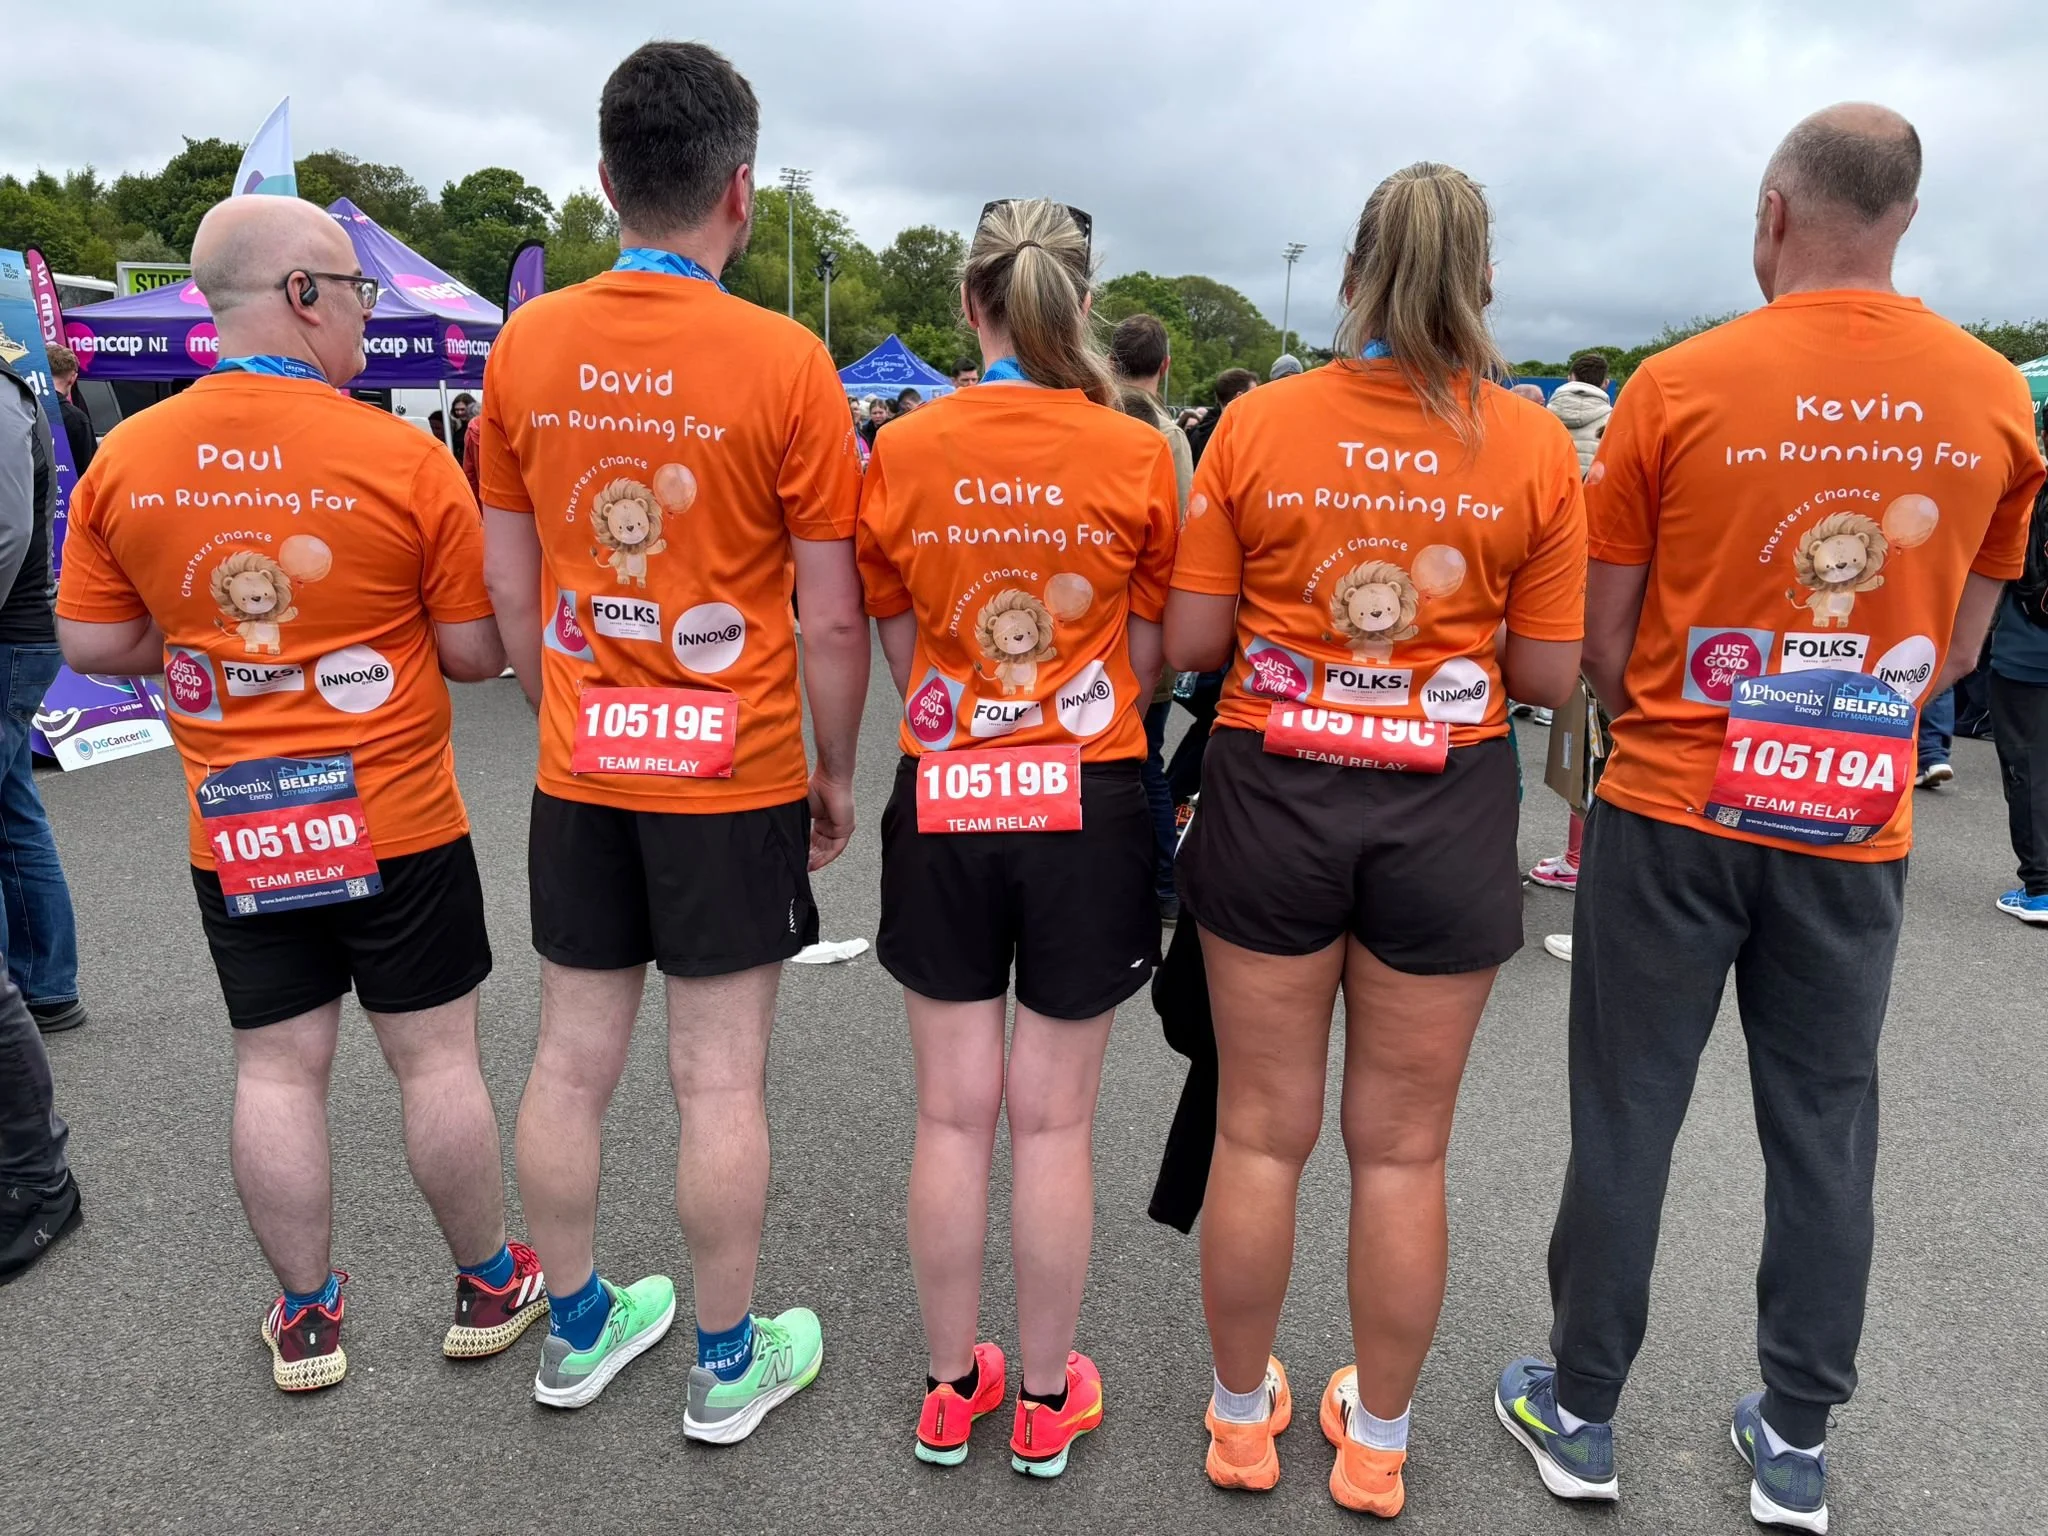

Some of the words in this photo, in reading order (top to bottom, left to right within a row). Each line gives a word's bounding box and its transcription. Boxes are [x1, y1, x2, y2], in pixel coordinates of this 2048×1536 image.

[148, 337, 168, 353] NI
[413, 337, 434, 353] NI
[579, 363, 673, 396] David
[1796, 393, 1923, 422] Kevin
[531, 410, 560, 428] Im
[568, 409, 676, 443] Running
[684, 415, 727, 441] For
[197, 444, 282, 471] Paul
[600, 455, 648, 470] Chance
[1337, 441, 1438, 475] Tara
[1725, 446, 1767, 465] Im
[1780, 440, 1922, 470] Running
[1934, 442, 1981, 470] For
[131, 491, 164, 509] Im
[175, 488, 301, 514] Running
[310, 489, 358, 511] For
[954, 477, 1064, 506] Claire
[1814, 487, 1881, 504] Chance
[1267, 490, 1303, 509] Im
[1315, 487, 1446, 522] Running
[1457, 494, 1504, 521] For
[214, 530, 273, 545] Chance
[912, 528, 938, 546] Im
[947, 523, 1067, 552] Running
[1077, 524, 1117, 545] For
[1347, 536, 1408, 552] Chance
[983, 567, 1038, 584] Chance
[593, 602, 659, 625] FOLKS.
[1709, 643, 1750, 658] JUST
[1783, 639, 1864, 659] FOLKS.
[173, 660, 197, 675] JUST
[1262, 656, 1294, 677] JUST
[1703, 654, 1750, 669] GOOD
[170, 670, 202, 687] GOOD
[224, 666, 302, 682] FOLKS.
[1326, 669, 1409, 689] FOLKS.
[1752, 681, 1825, 707] Phoenix
[1794, 704, 1823, 717] Energy
[1831, 710, 1849, 719] CITY
[1849, 712, 1891, 724] MARATHON
[1833, 697, 1909, 718] BELFAST
[585, 703, 724, 743] 10519E
[92, 728, 151, 750] OGCancerNI
[598, 756, 640, 770] TEAM
[645, 758, 700, 773] RELAY
[1295, 748, 1343, 765] TEAM
[1349, 757, 1408, 770] RELAY
[1731, 737, 1895, 793] 10519A
[210, 778, 272, 799] Phoenix
[279, 770, 347, 790] BELFAST
[923, 762, 1068, 800] 10519B
[249, 792, 274, 801] Energy
[282, 789, 298, 797] CITY
[298, 785, 333, 796] MARATHON
[1744, 793, 1796, 814] TEAM
[1800, 801, 1861, 822] RELAY
[946, 817, 992, 832] TEAM
[996, 815, 1049, 830] RELAY
[1745, 817, 1844, 838] www.belfastcitymarathon.com
[214, 813, 357, 862] 10519D
[247, 872, 292, 890] TEAM
[294, 865, 346, 884] RELAY
